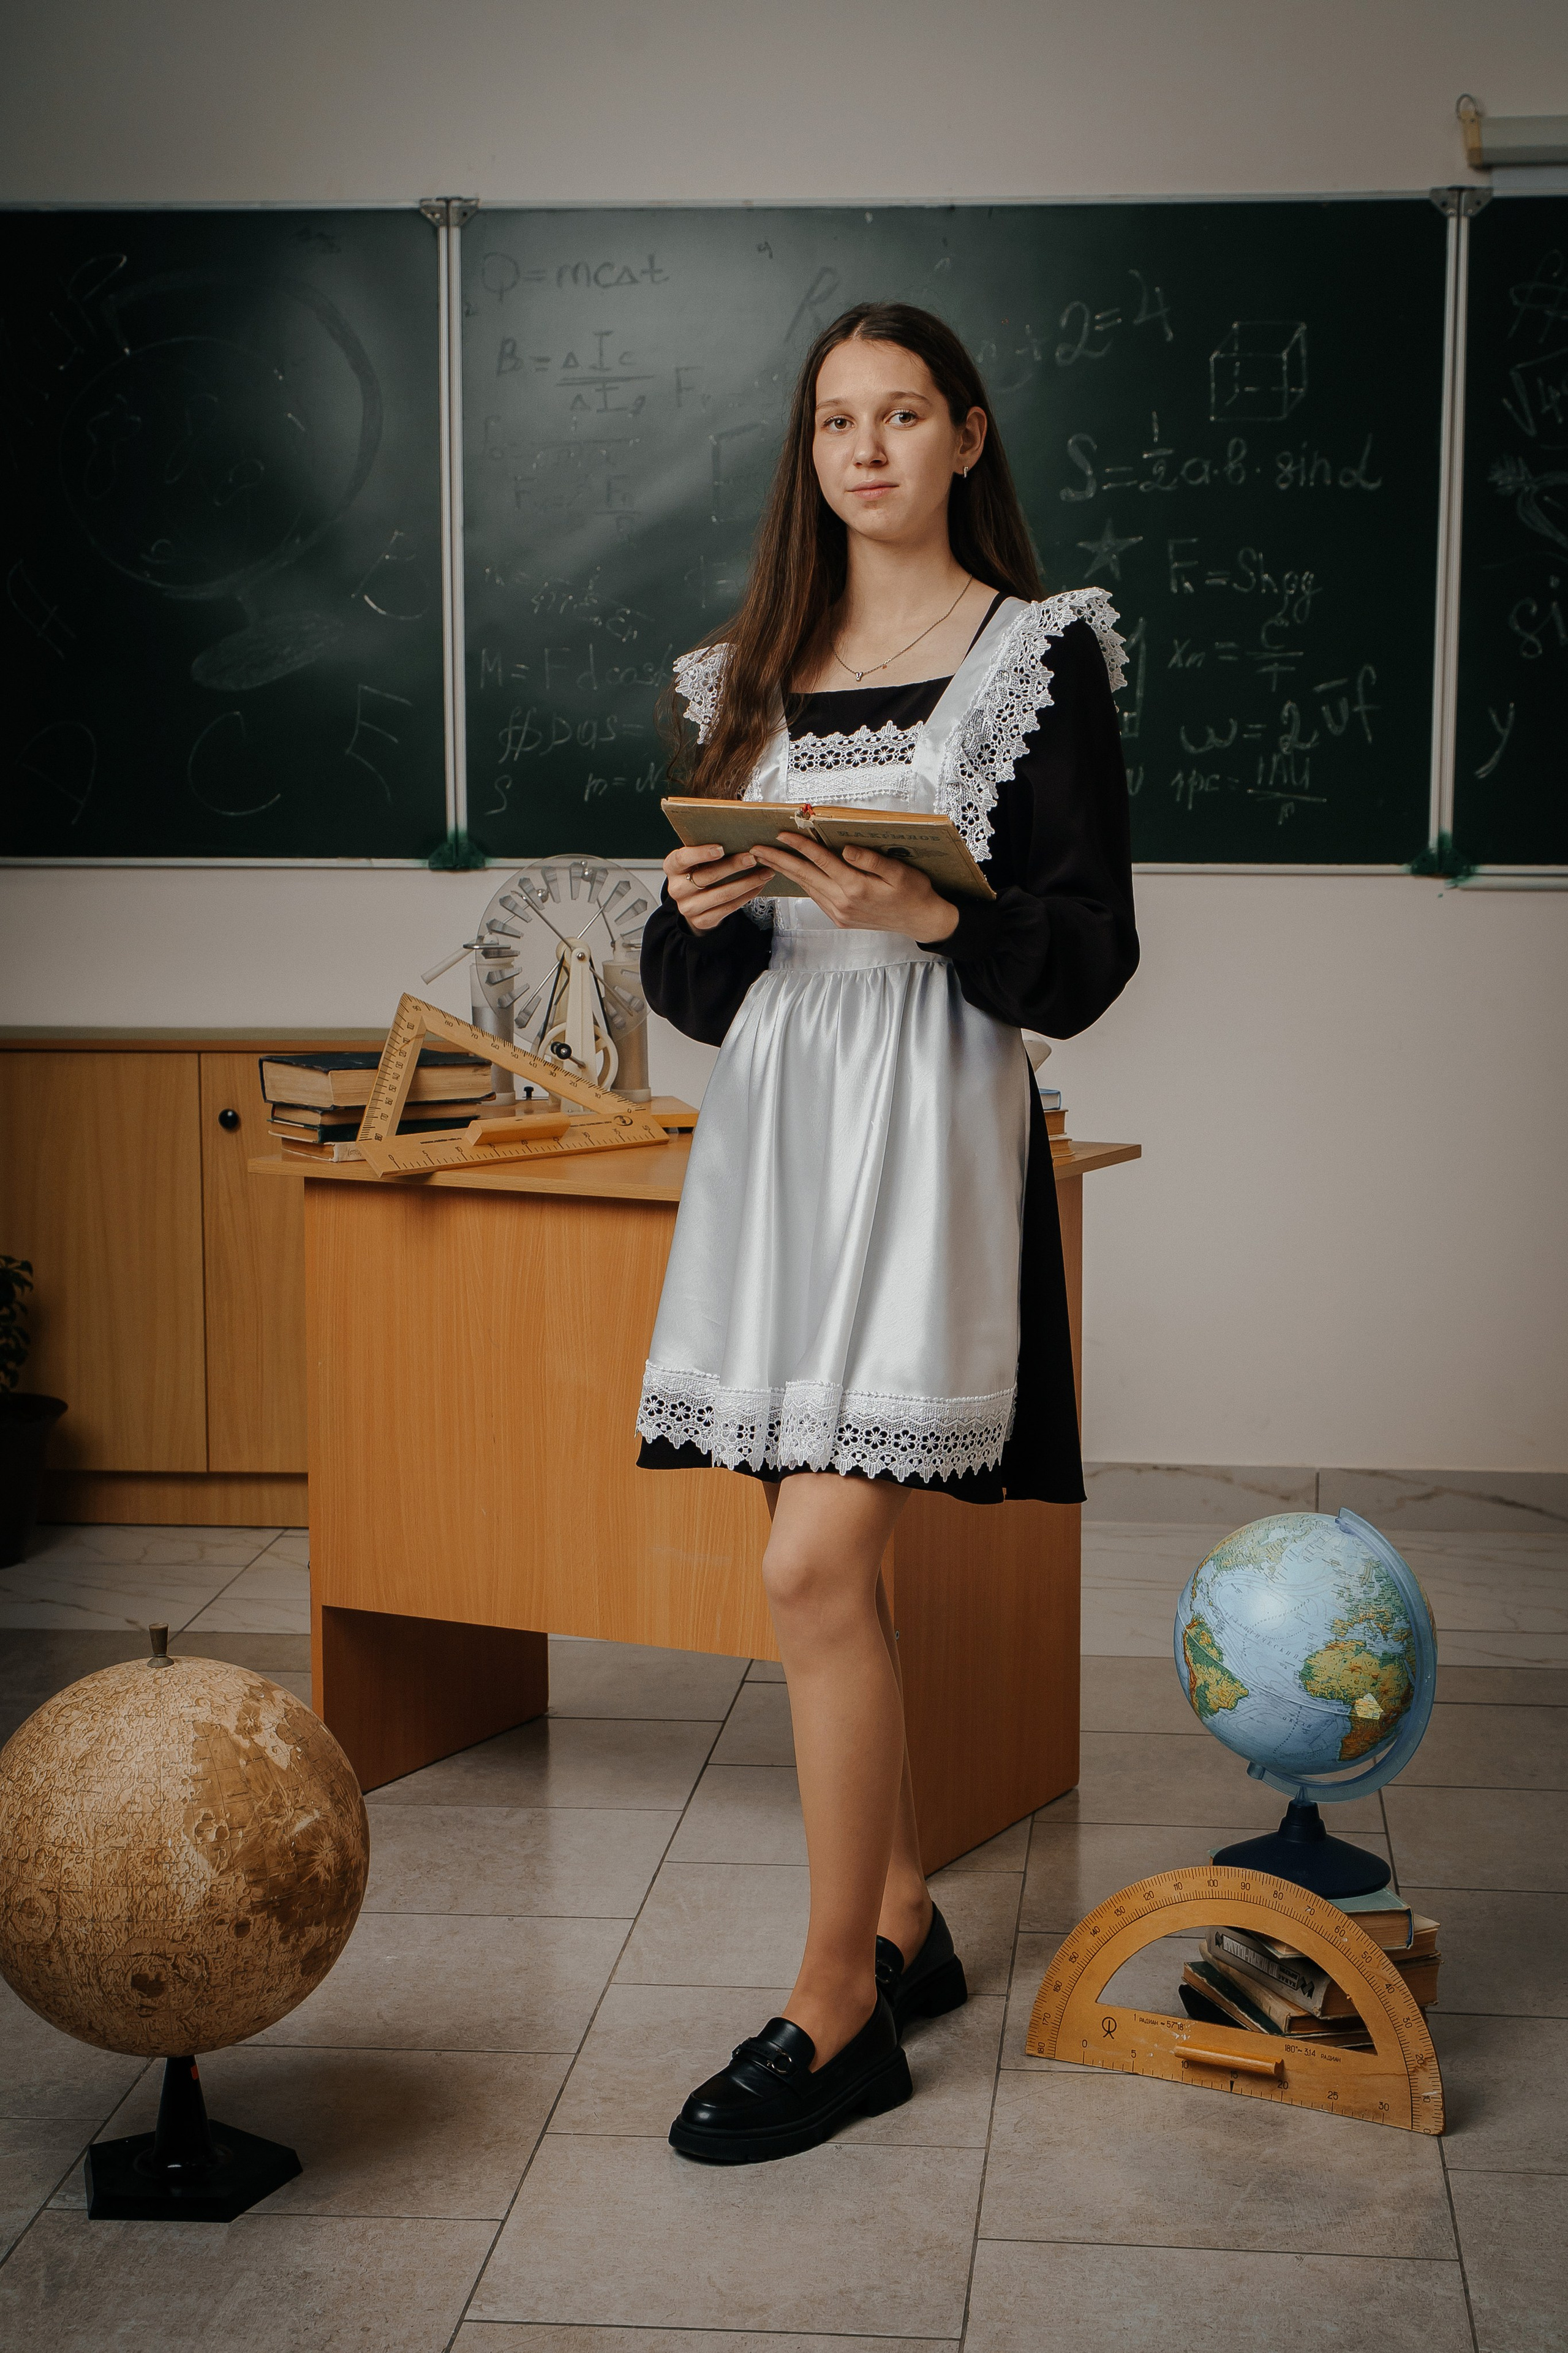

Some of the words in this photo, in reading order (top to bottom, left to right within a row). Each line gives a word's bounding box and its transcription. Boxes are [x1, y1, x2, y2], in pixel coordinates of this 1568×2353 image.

[1173, 1881, 1183, 1892] 110
[1207, 1879, 1218, 1888] 100
[1240, 1881, 1251, 1891] 90
[1143, 1890, 1155, 1901] 120
[1273, 1890, 1284, 1900] 80
[1114, 1905, 1126, 1917] 130
[1305, 1905, 1316, 1916] 70
[1090, 1925, 1101, 1938] 140
[1334, 1925, 1346, 1938] 60
[1068, 1951, 1079, 1964] 150
[1361, 1951, 1373, 1964] 50
[1053, 1980, 1063, 1993] 160
[1384, 1982, 1395, 1995] 40
[1042, 2012, 1051, 2026] 170
[1402, 2016, 1413, 2029] 30
[1037, 2042, 1046, 2054] 180
[1321, 2054, 1341, 2063] РАДИАН
[1415, 2053, 1425, 2065] 20
[1082, 2039, 1088, 2048] 0
[1131, 2049, 1137, 2058] 5
[1181, 2060, 1189, 2069] 10
[1230, 2070, 1238, 2079] 15
[1277, 2079, 1289, 2090] 20
[1327, 2090, 1339, 2101] 25
[1378, 2101, 1390, 2112] 30
